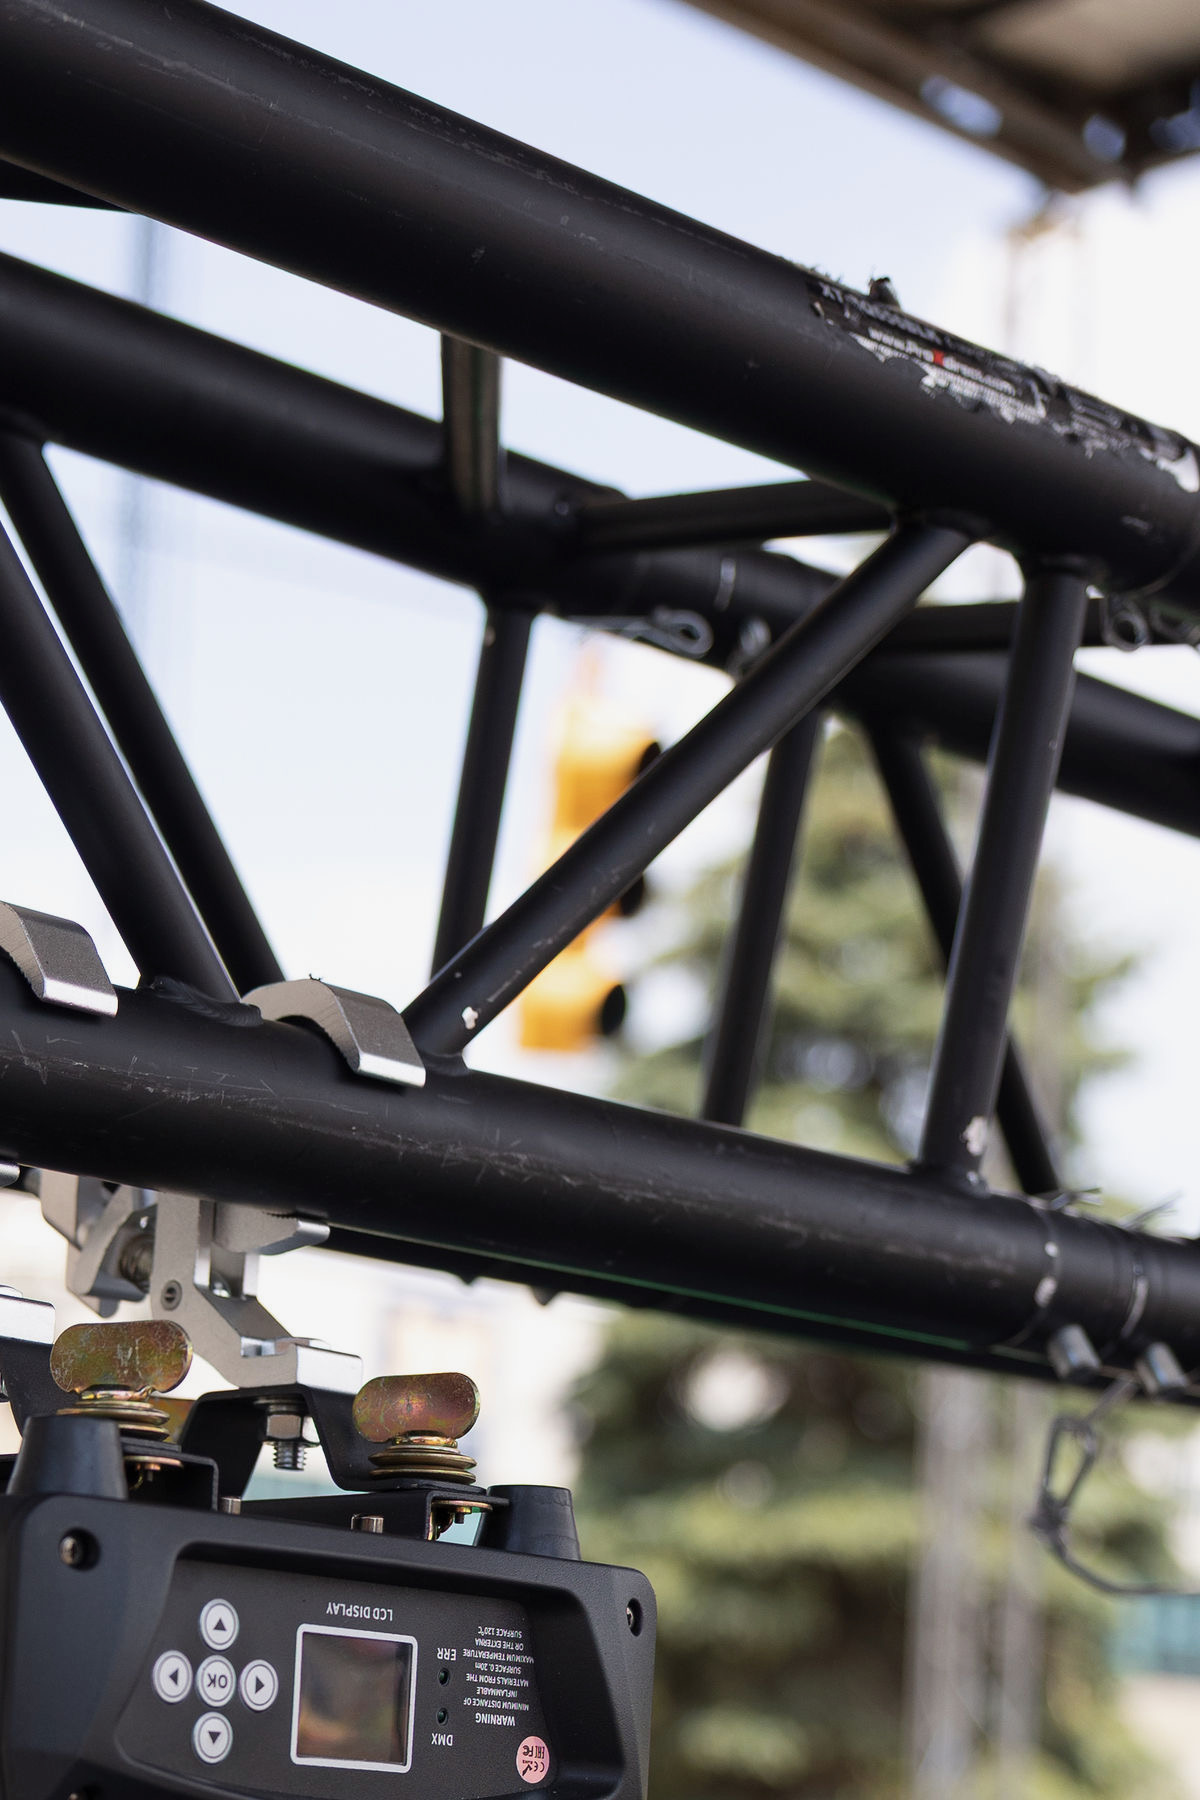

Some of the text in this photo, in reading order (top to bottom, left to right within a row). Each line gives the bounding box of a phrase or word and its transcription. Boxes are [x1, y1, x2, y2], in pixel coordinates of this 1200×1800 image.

[326, 1601, 393, 1621] LCD DISPLAY
[495, 1628, 522, 1638] SURFACE
[474, 1638, 524, 1650] OR THE EXTERNA
[437, 1647, 456, 1660] ERR
[462, 1648, 534, 1663] MAXIMUM TEMPERATURE
[495, 1664, 521, 1674] SURFACE
[206, 1673, 228, 1688] OK
[465, 1673, 528, 1687] MATERIALS FROM THE
[476, 1686, 517, 1697] INFLAMMABLE
[463, 1697, 529, 1711] MINIMUM DISTANCE OF
[475, 1712, 515, 1726] WARNING
[431, 1732, 453, 1745] DMX
